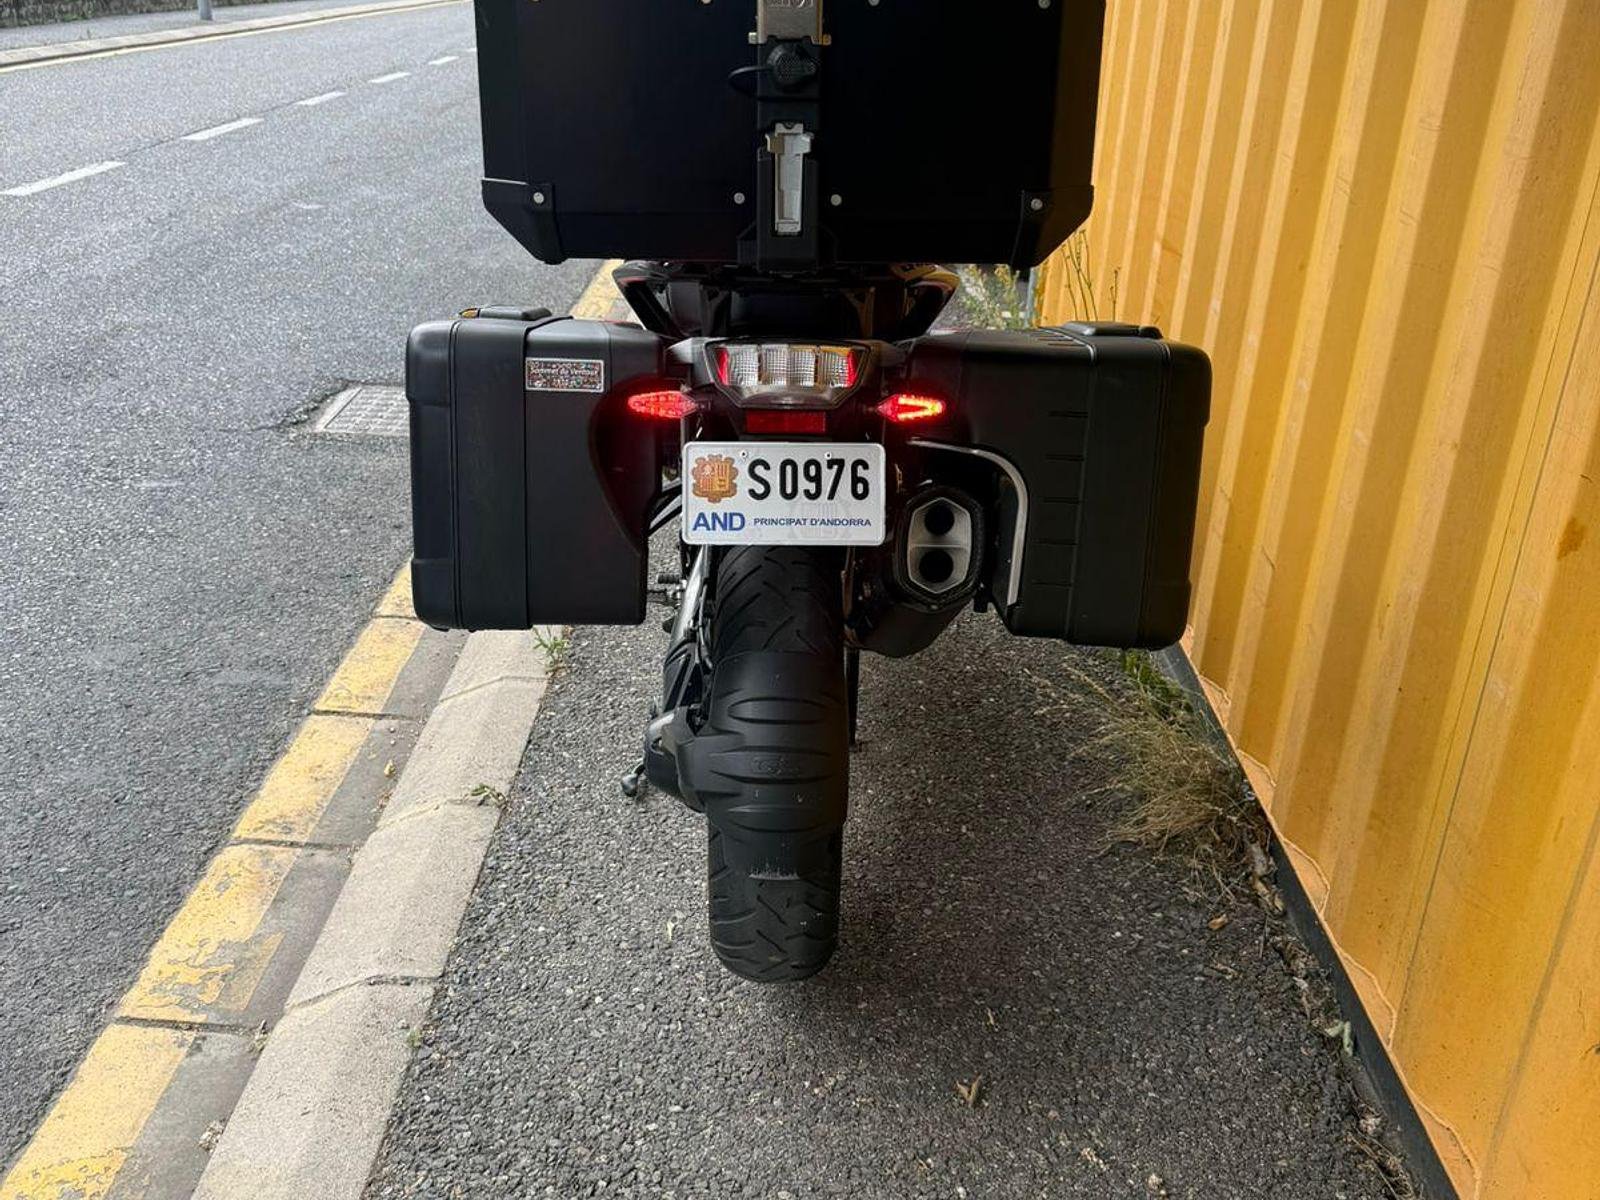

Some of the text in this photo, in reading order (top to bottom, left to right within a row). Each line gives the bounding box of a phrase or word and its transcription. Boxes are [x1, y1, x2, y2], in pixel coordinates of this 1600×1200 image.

[748, 458, 870, 501] S0976
[692, 512, 746, 532] AND
[753, 517, 872, 527] PRINCIPAT D'ANDORRA
